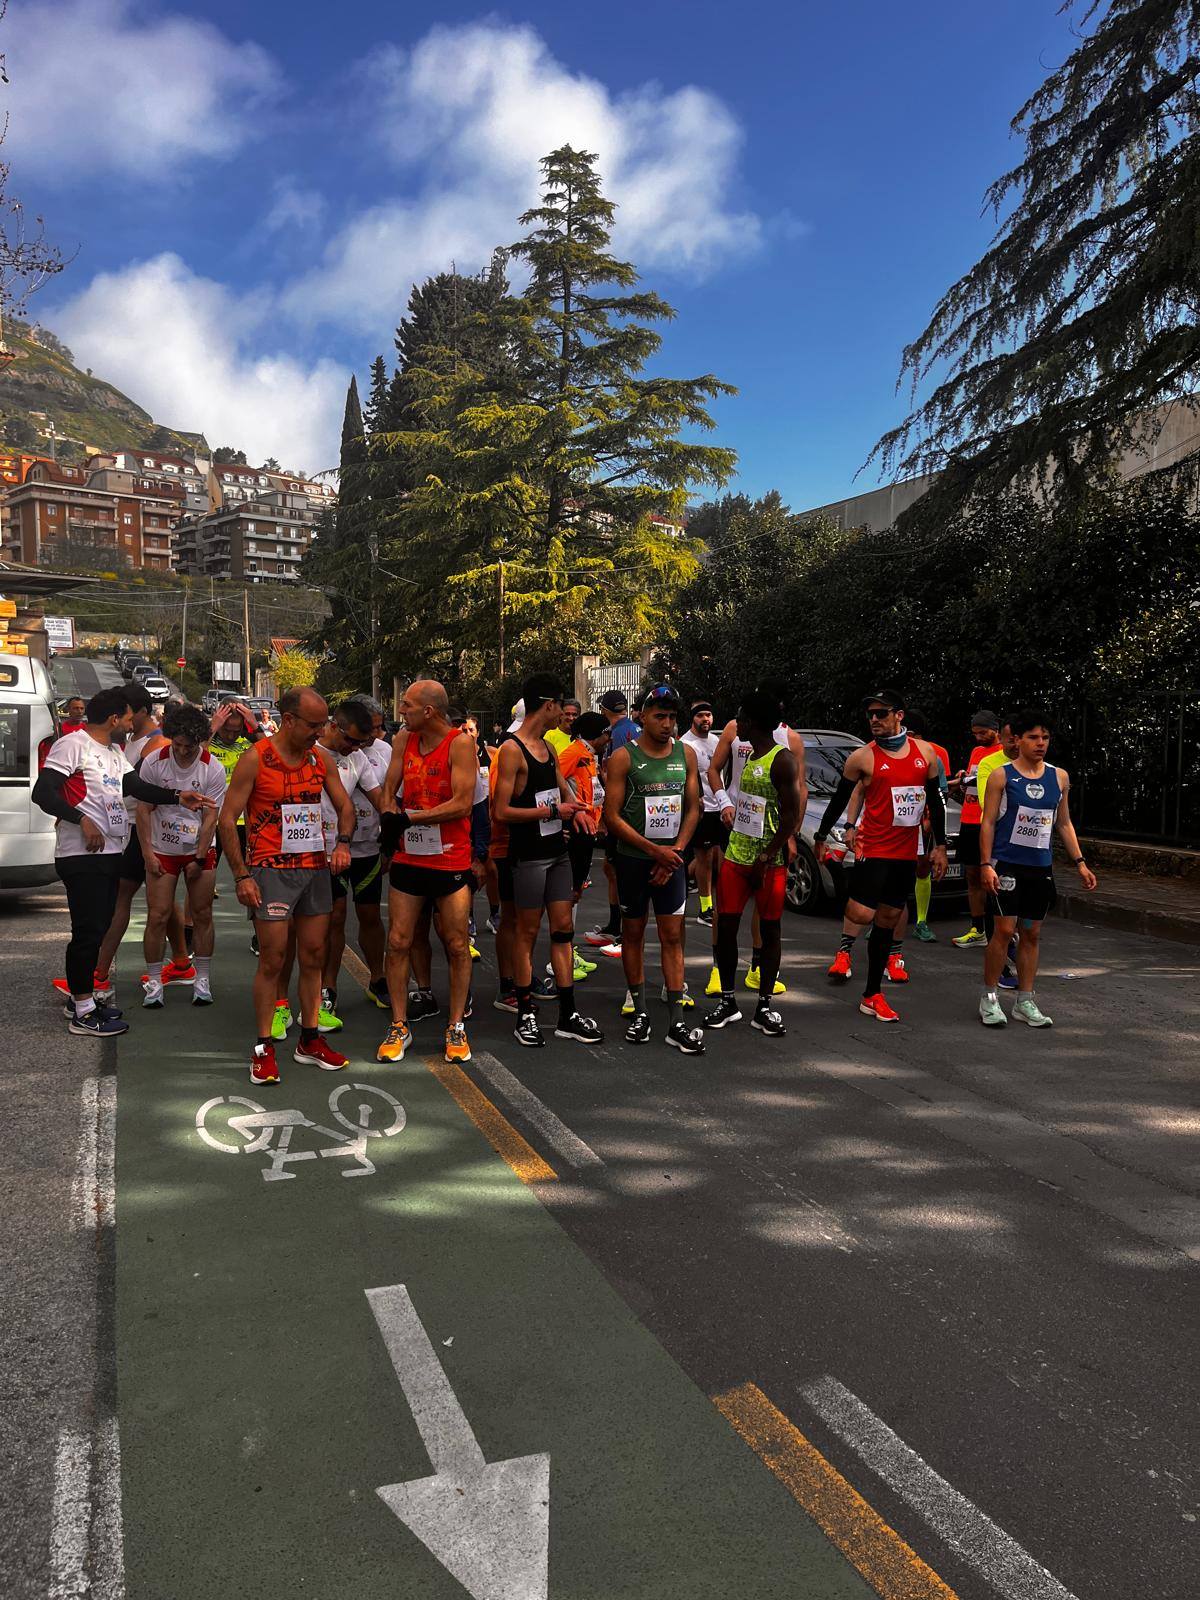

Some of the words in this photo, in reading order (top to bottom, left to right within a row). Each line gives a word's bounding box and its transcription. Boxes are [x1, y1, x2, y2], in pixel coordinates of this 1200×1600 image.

[897, 806, 915, 816] 2917
[649, 818, 669, 828] 2921
[737, 812, 751, 824] 2920
[287, 828, 310, 840] 2892
[407, 831, 423, 842] 2891
[1016, 825, 1038, 837] 2880
[161, 832, 180, 845] 2922
